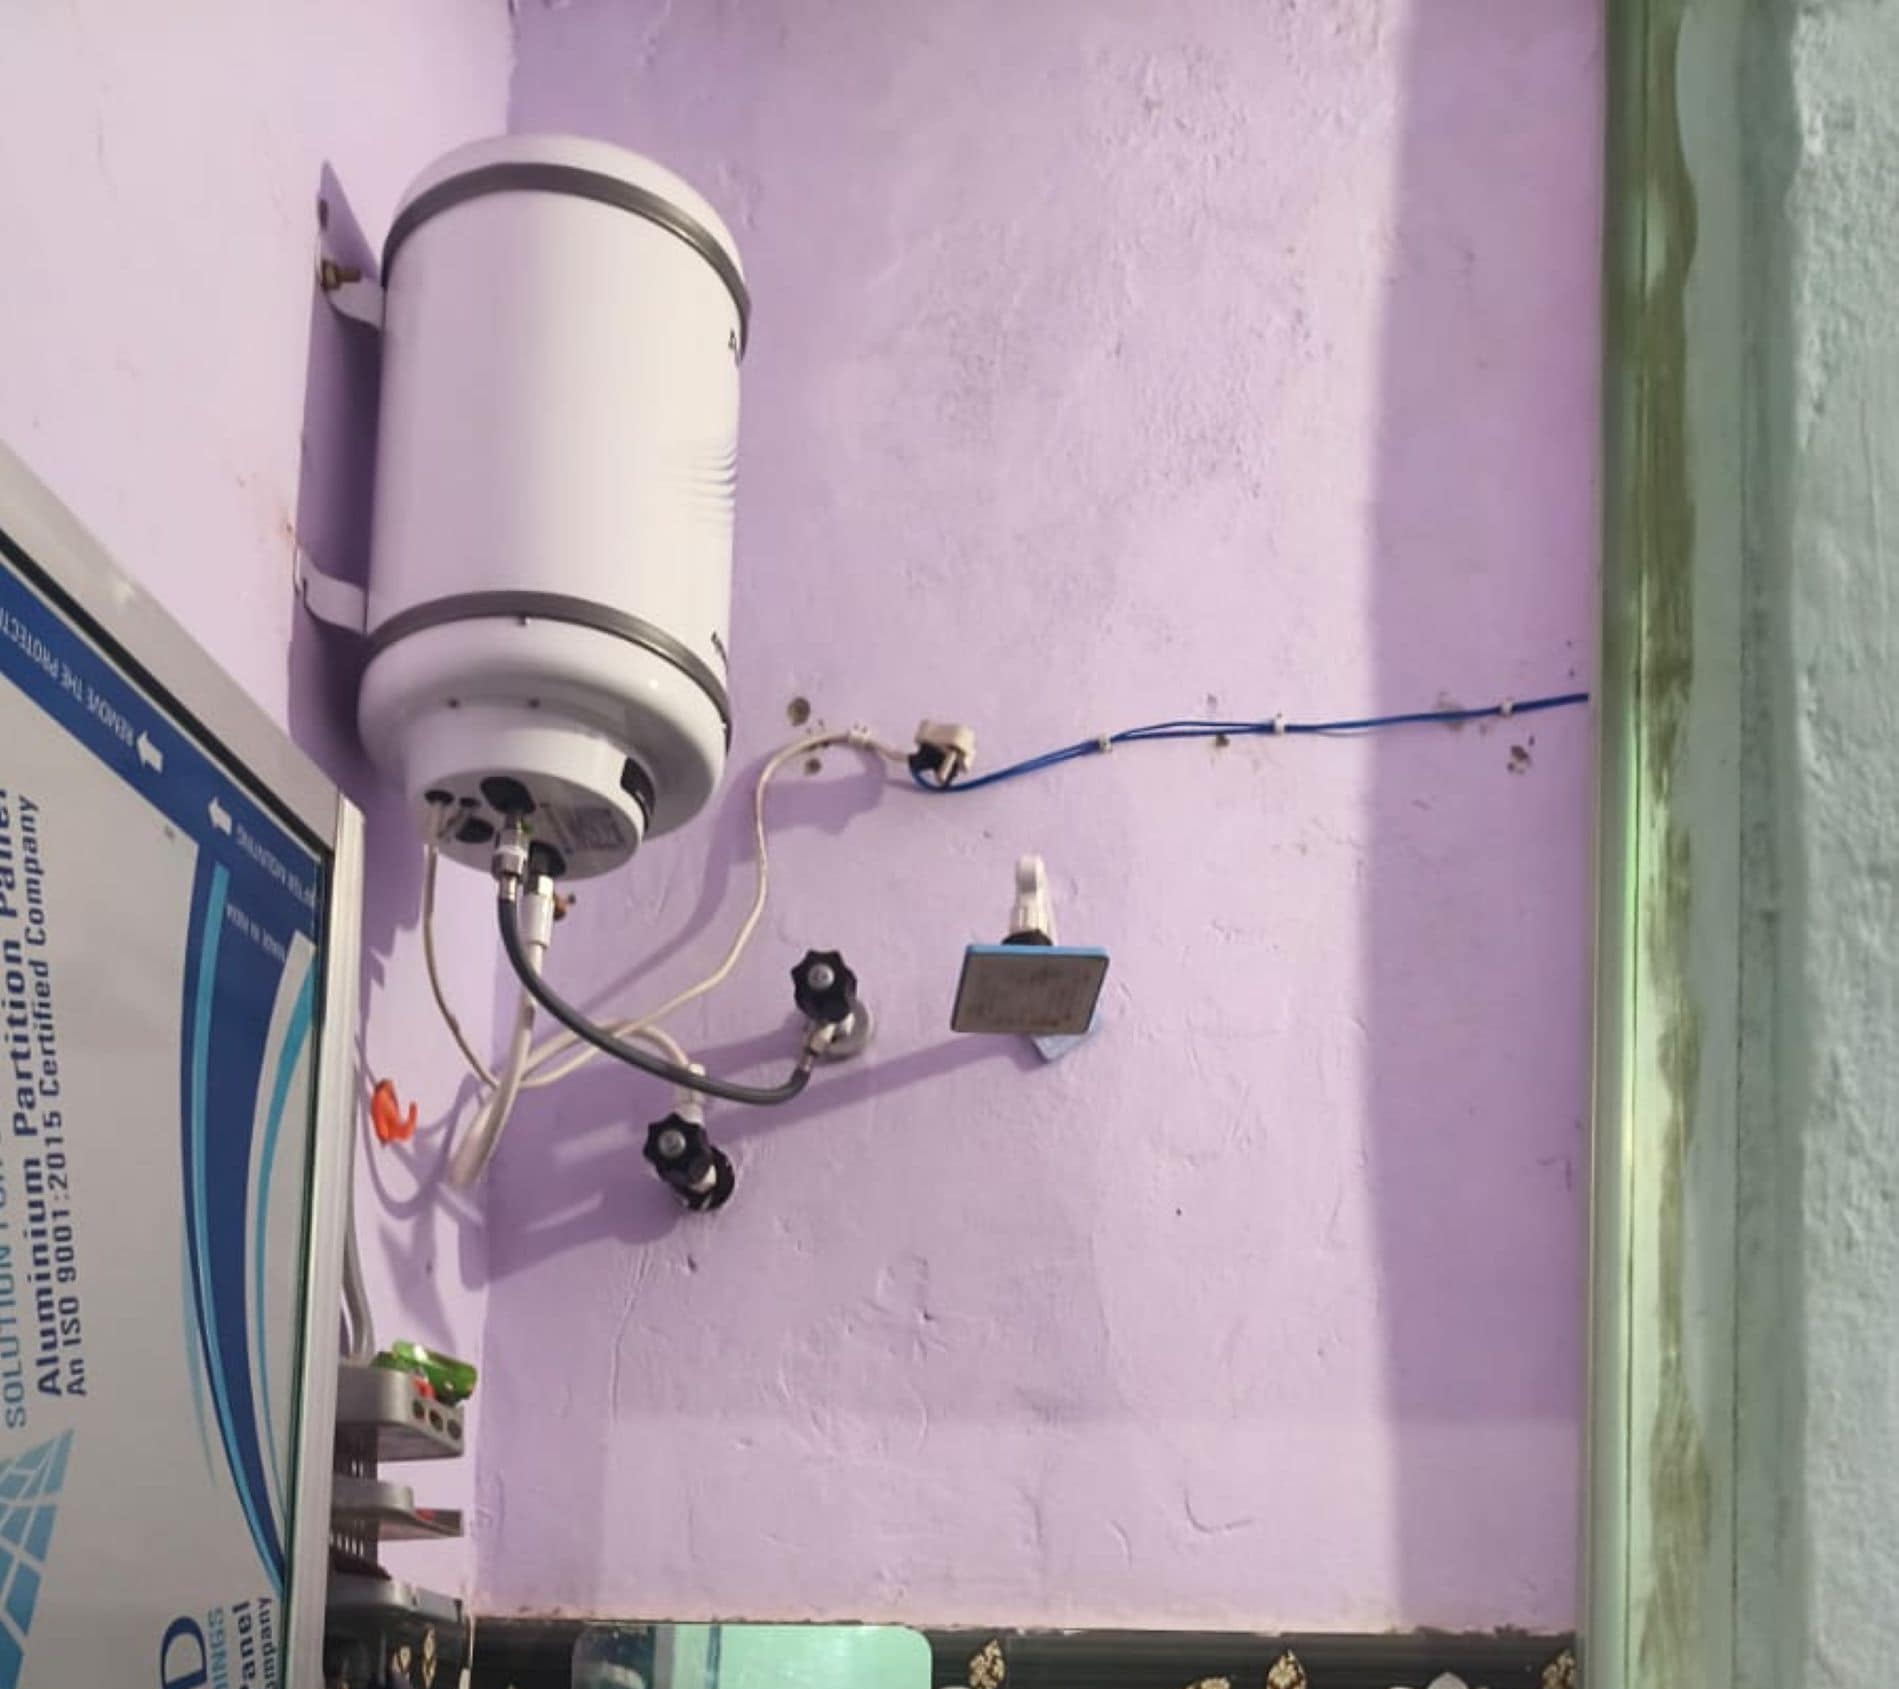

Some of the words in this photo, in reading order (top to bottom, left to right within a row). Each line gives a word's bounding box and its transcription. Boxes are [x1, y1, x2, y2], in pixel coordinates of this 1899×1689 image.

[61, 662, 82, 703] THE
[87, 685, 134, 747] REMOVE
[18, 793, 46, 946] Company
[1, 936, 38, 1137] Partition
[28, 958, 60, 1096] Certified
[42, 1110, 77, 1282] 9001:2015
[23, 1156, 62, 1397] Aluminium
[58, 1295, 82, 1346] ISO
[65, 1357, 87, 1397] An
